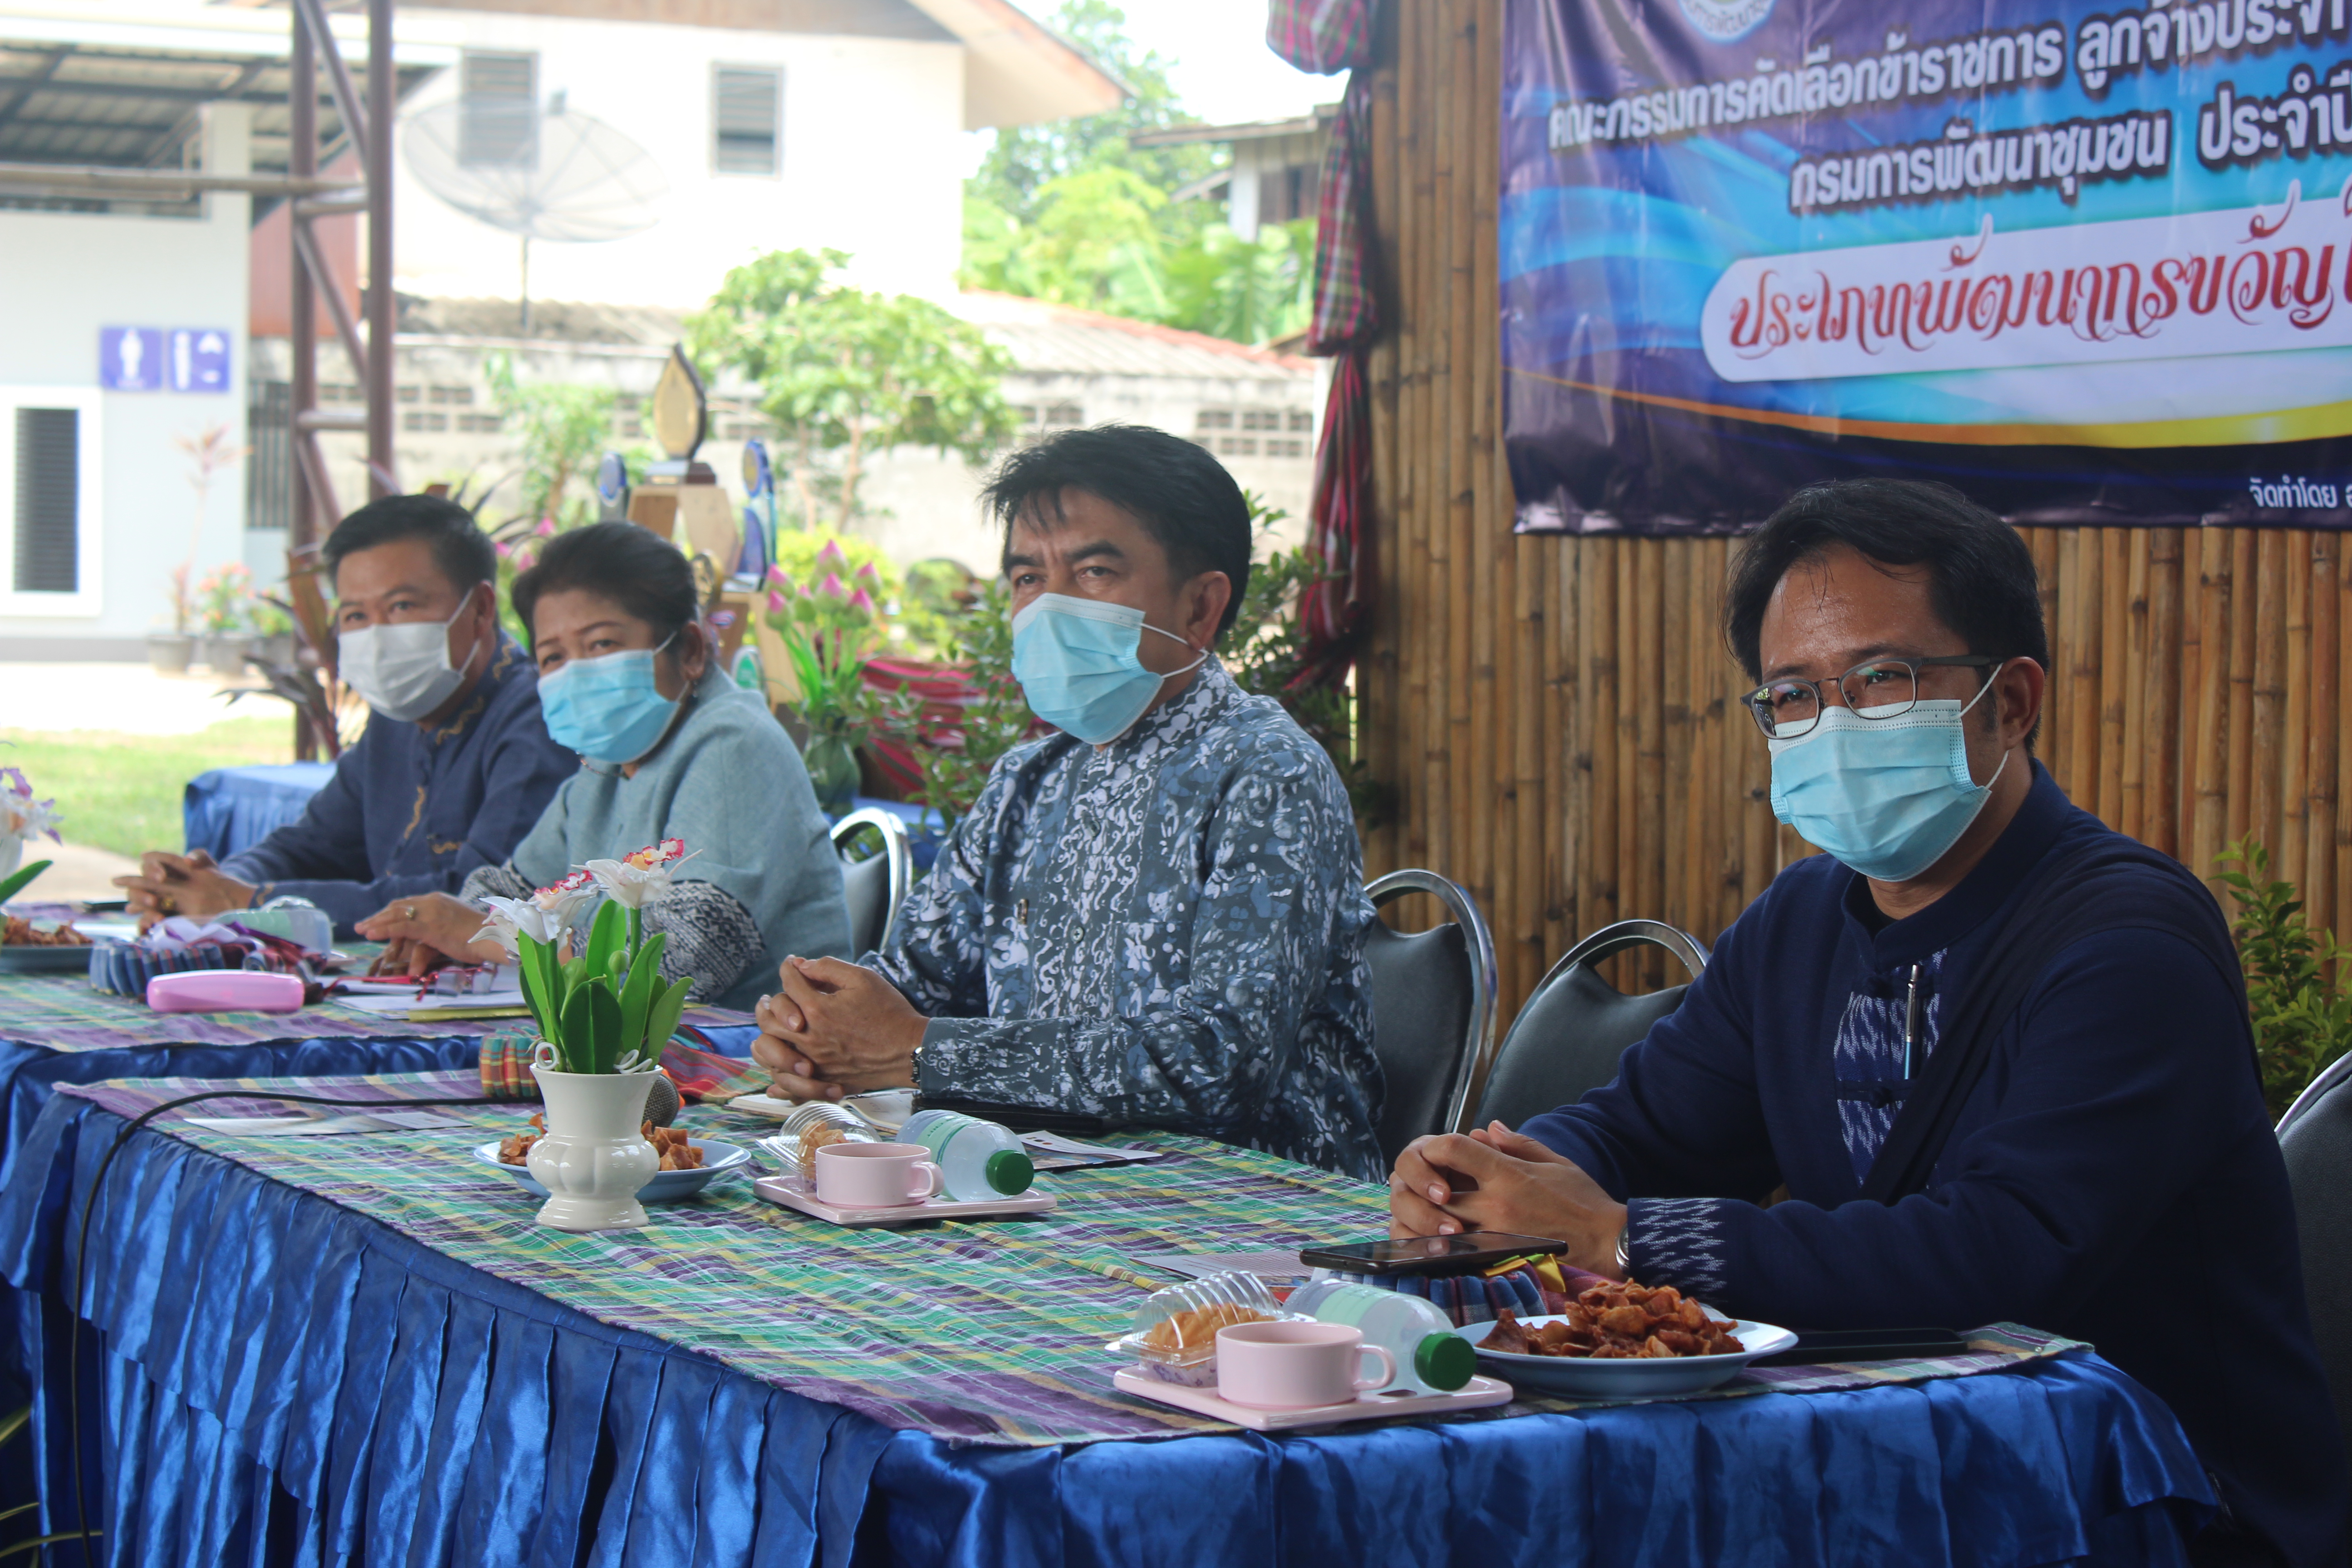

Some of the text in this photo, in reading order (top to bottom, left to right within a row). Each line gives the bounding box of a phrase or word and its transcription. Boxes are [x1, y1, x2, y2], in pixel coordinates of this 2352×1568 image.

[1549, 28, 2063, 148] คณะกรรมการคัดเลือกข้าราชการ
[1792, 117, 2167, 207] กรมการพัฒนาชุมชน
[2249, 474, 2337, 508] จัดทำโดย
